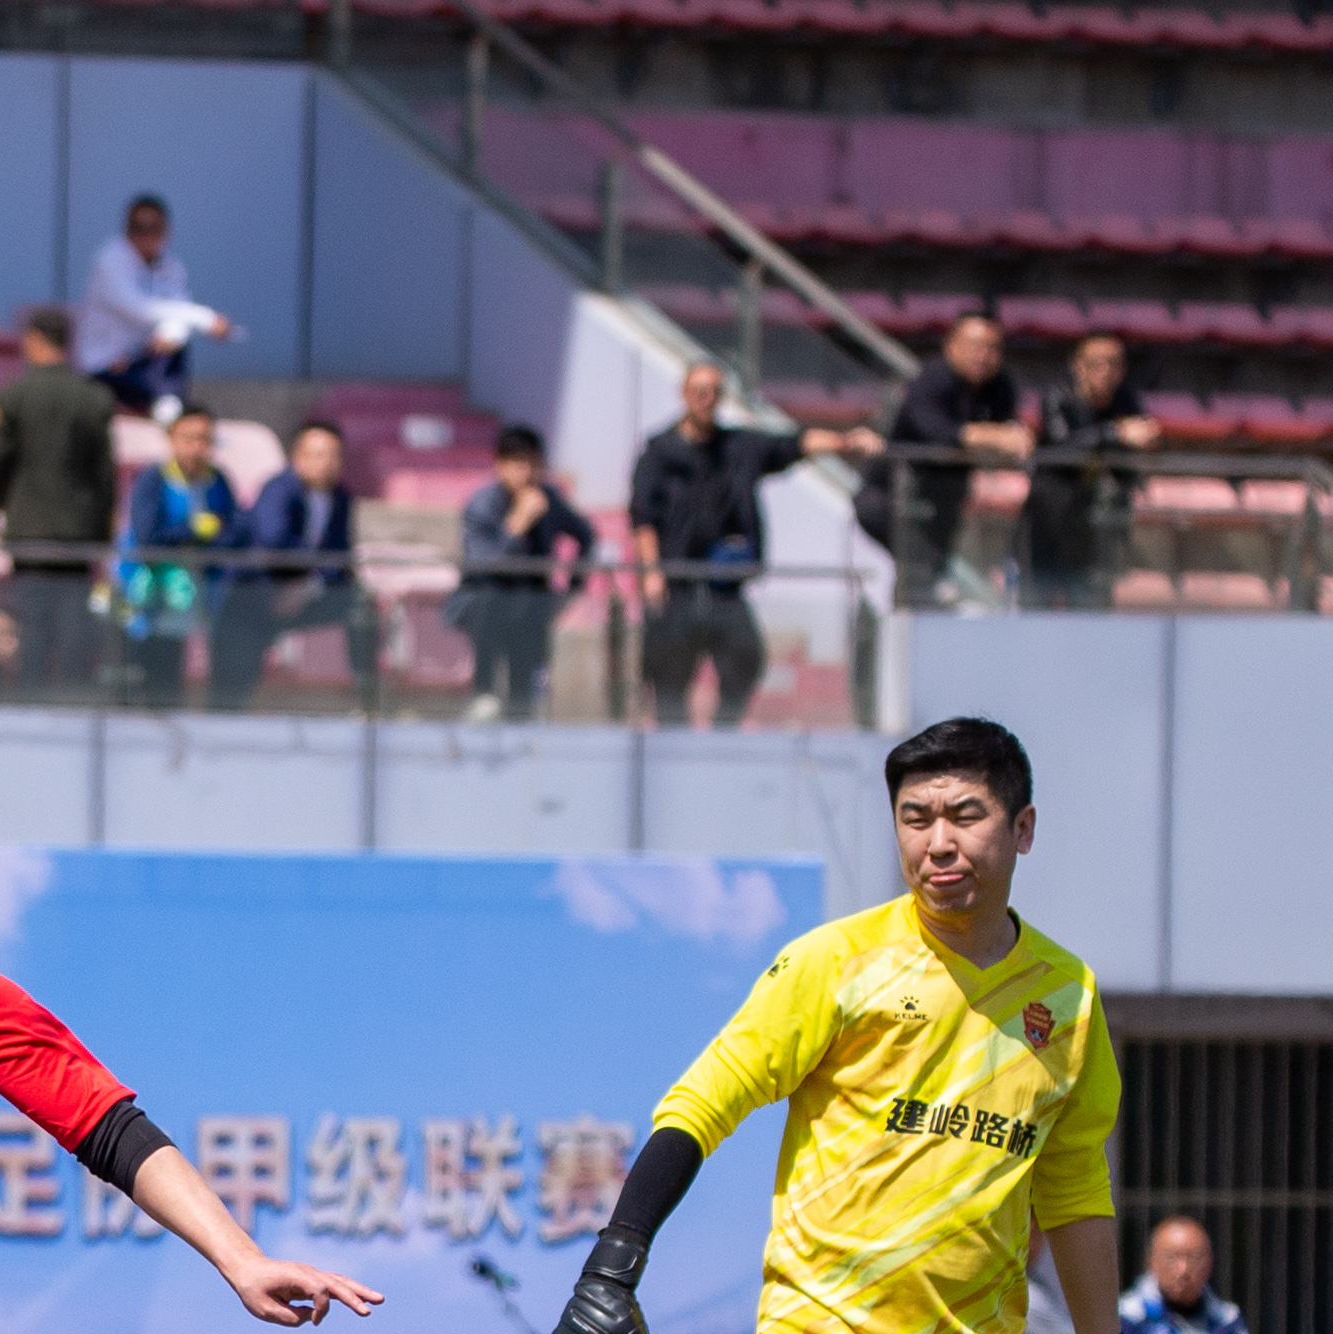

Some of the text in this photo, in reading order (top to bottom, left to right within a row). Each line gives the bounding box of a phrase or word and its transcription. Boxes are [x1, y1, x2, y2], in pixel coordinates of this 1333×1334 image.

[894, 1012, 929, 1021] KELME
[885, 1097, 1039, 1160] 建岭路桥
